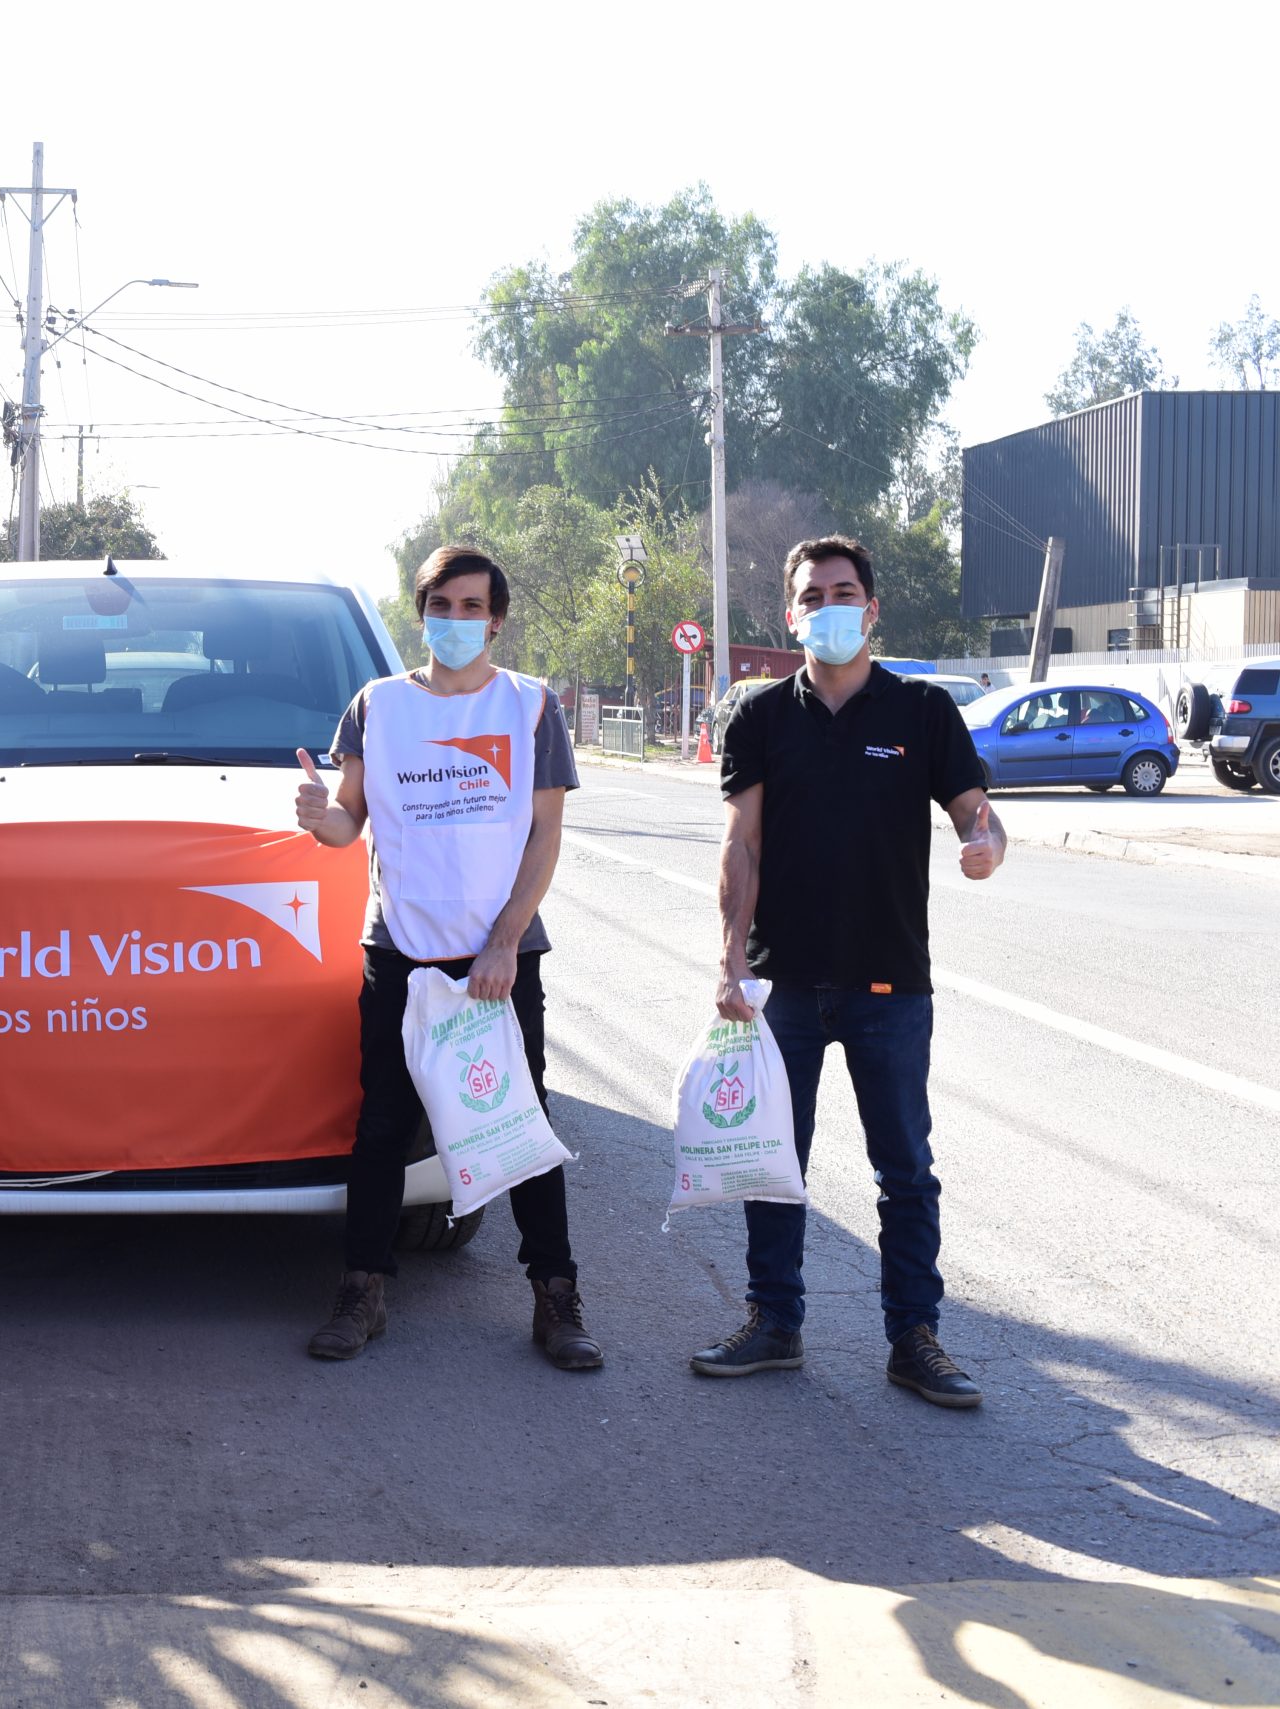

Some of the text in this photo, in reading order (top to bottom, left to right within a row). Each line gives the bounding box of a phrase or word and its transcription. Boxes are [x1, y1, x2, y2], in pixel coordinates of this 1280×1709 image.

[397, 765, 488, 784] World Vision
[459, 778, 490, 791] Chile
[402, 794, 507, 812] Construyendo un futuro mejor
[415, 812, 433, 821] para
[434, 810, 445, 819] los
[465, 804, 495, 814] chilenos
[88, 929, 262, 976] Vision
[46, 996, 149, 1033] niños
[454, 1033, 476, 1046] OTROS
[476, 1023, 492, 1036] USOS
[448, 1132, 486, 1153] MOLINERA
[486, 1127, 501, 1137] SAN
[501, 1113, 524, 1131] FELIPE
[680, 1145, 715, 1155] MOLINERA
[716, 1144, 732, 1154] SAN
[734, 1141, 761, 1151] FELIPE
[459, 1168, 472, 1185] 5
[681, 1173, 691, 1191] 5
